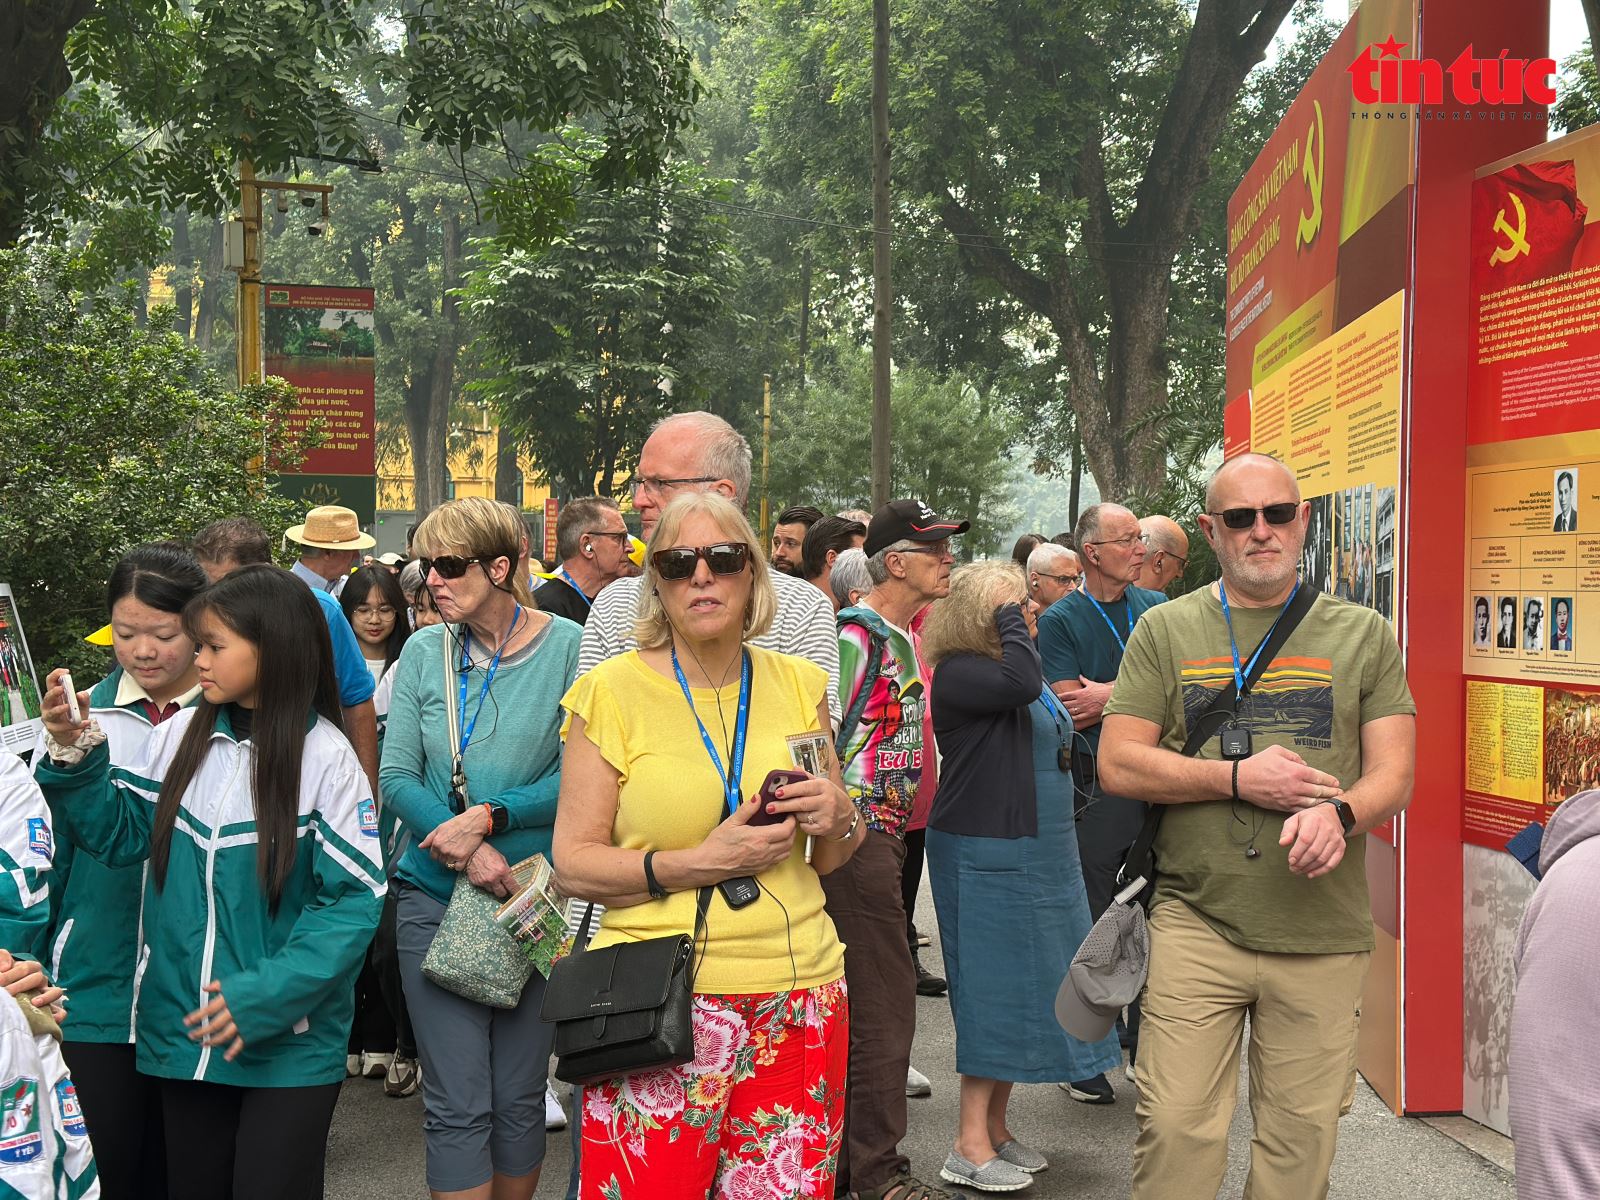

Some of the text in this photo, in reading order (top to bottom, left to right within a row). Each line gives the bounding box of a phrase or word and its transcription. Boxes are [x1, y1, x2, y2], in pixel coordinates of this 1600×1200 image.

[1282, 140, 1298, 183] NAM
[1293, 737, 1332, 749] WEIRD FISH
